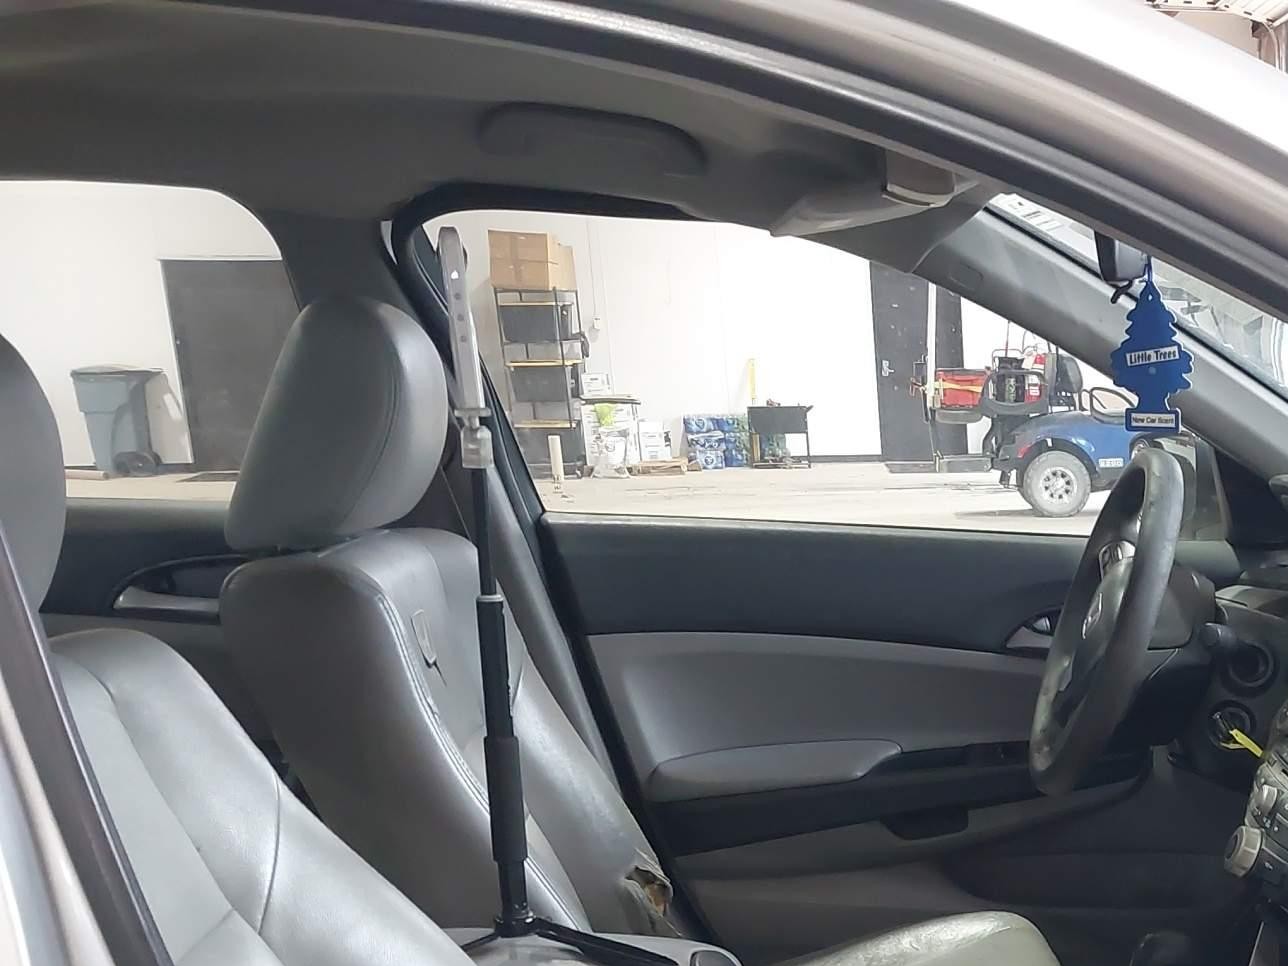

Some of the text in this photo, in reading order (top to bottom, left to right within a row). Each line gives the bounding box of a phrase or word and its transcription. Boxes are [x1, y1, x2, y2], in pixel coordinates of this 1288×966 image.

[1129, 349, 1177, 364] Little Trees
[1146, 416, 1157, 424] Car
